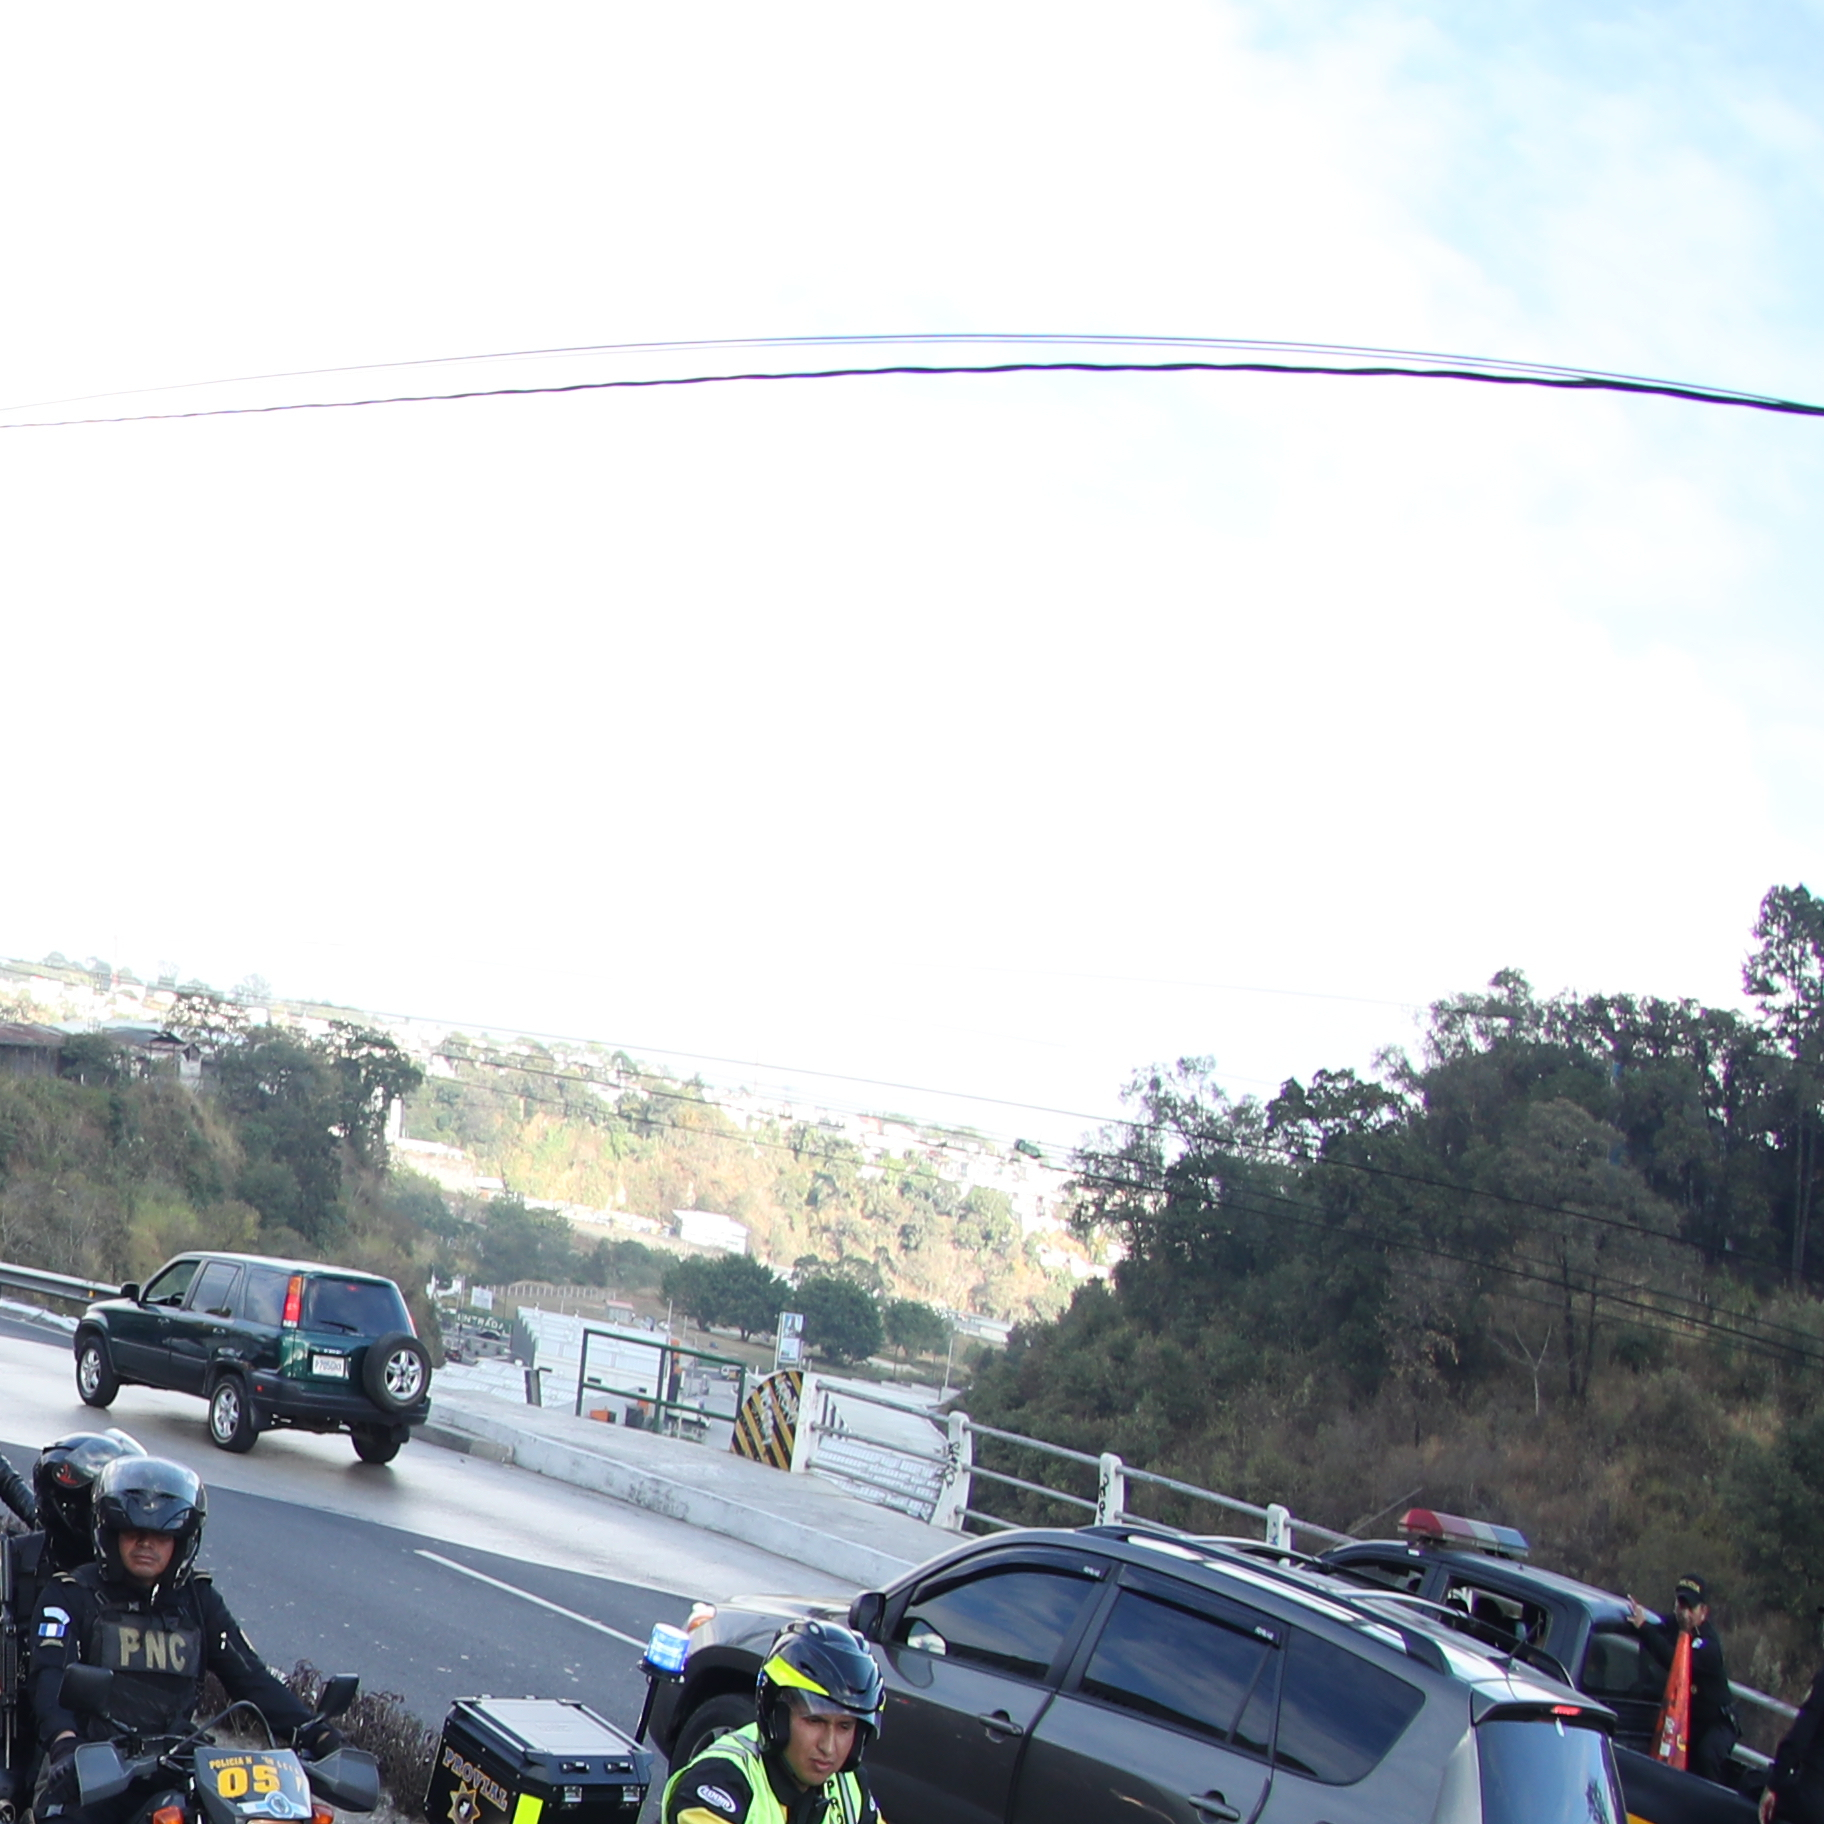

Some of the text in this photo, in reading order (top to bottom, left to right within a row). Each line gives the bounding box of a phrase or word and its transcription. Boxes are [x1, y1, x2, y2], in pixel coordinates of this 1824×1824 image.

[118, 1626, 187, 1673] PNC
[208, 1757, 245, 1770] POLICIA
[217, 1764, 281, 1799] 05
[442, 1746, 508, 1812] PROVIAL
